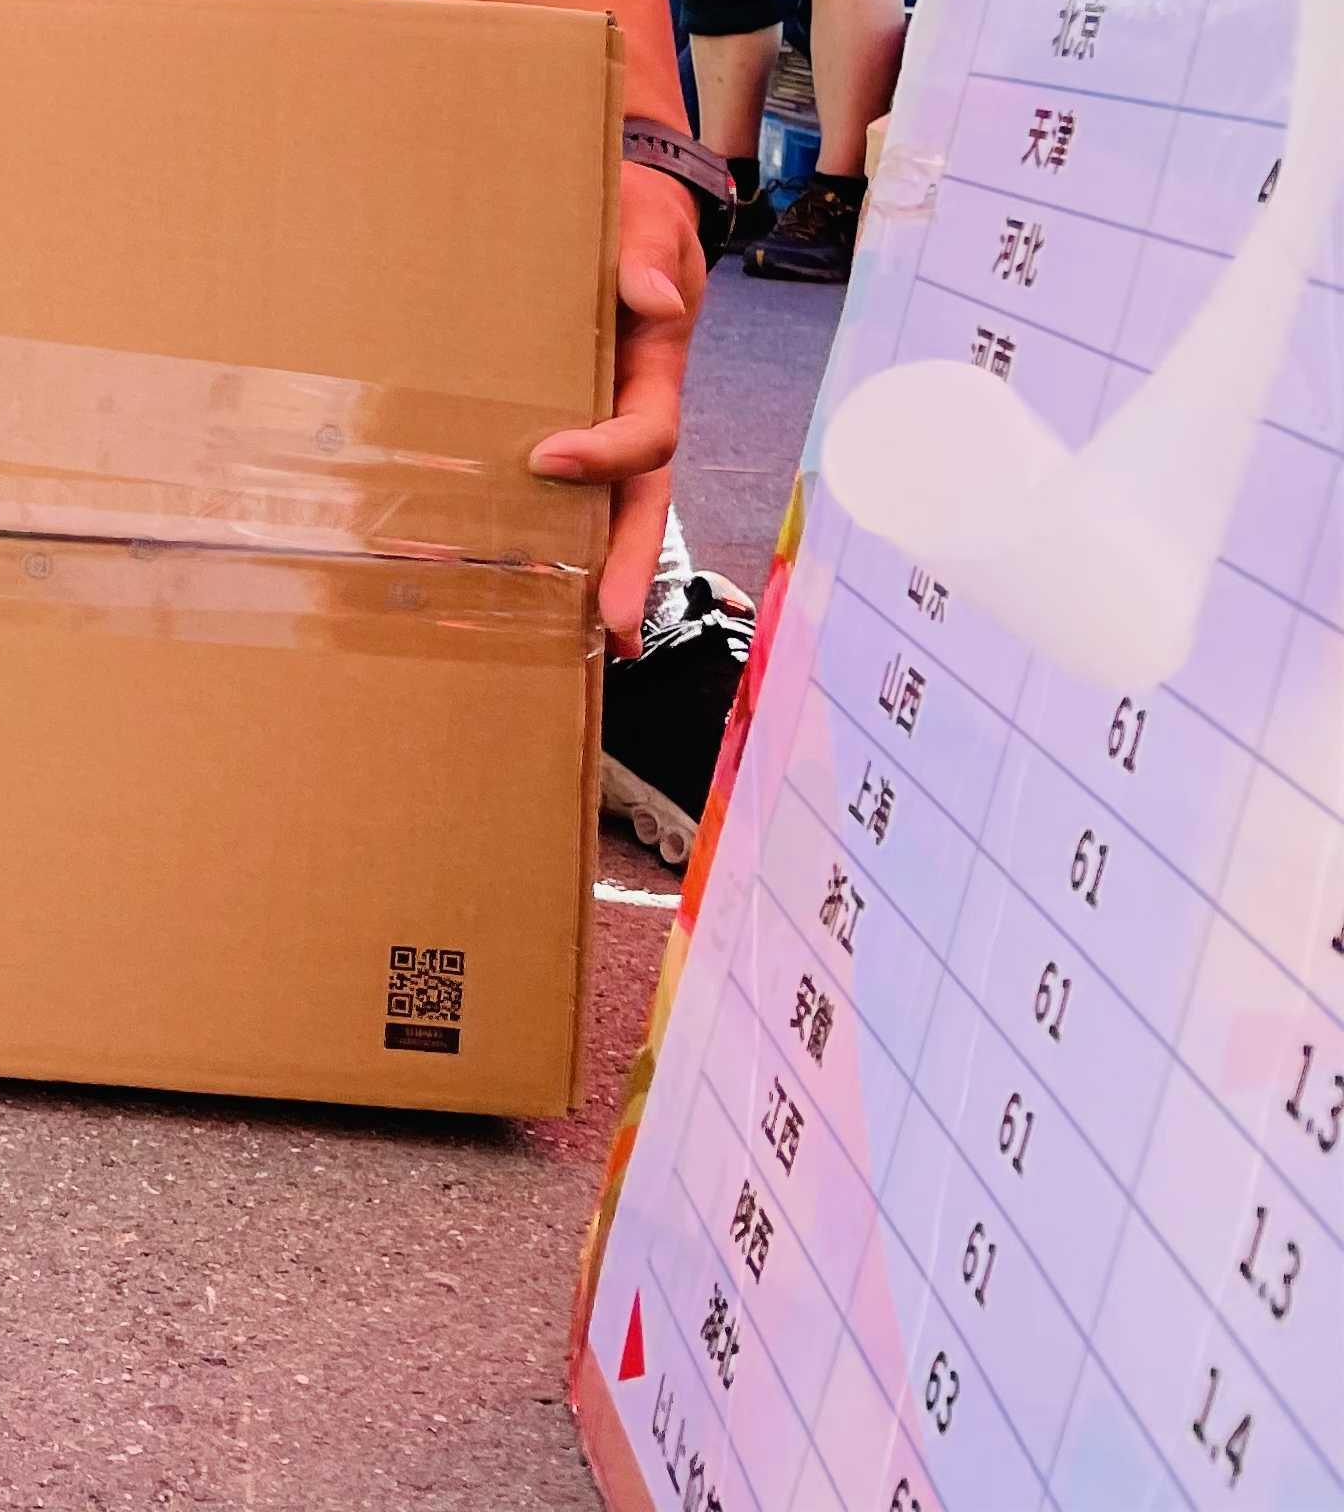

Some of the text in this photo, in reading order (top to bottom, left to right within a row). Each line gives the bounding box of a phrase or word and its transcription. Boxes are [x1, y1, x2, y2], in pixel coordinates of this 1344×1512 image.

[1021, 109, 1076, 174] 天津
[991, 216, 1045, 288] 河北
[878, 653, 926, 738] 山西
[1108, 697, 1147, 773] 61
[848, 759, 896, 845] 上海
[819, 863, 866, 954] 浙江
[1071, 829, 1109, 909] 61
[790, 974, 834, 1068] 安徽
[1034, 961, 1072, 1041] 61
[762, 1075, 804, 1176] 江西
[999, 1092, 1034, 1175] 61
[962, 1222, 997, 1309] 61
[925, 1351, 960, 1435] 63
